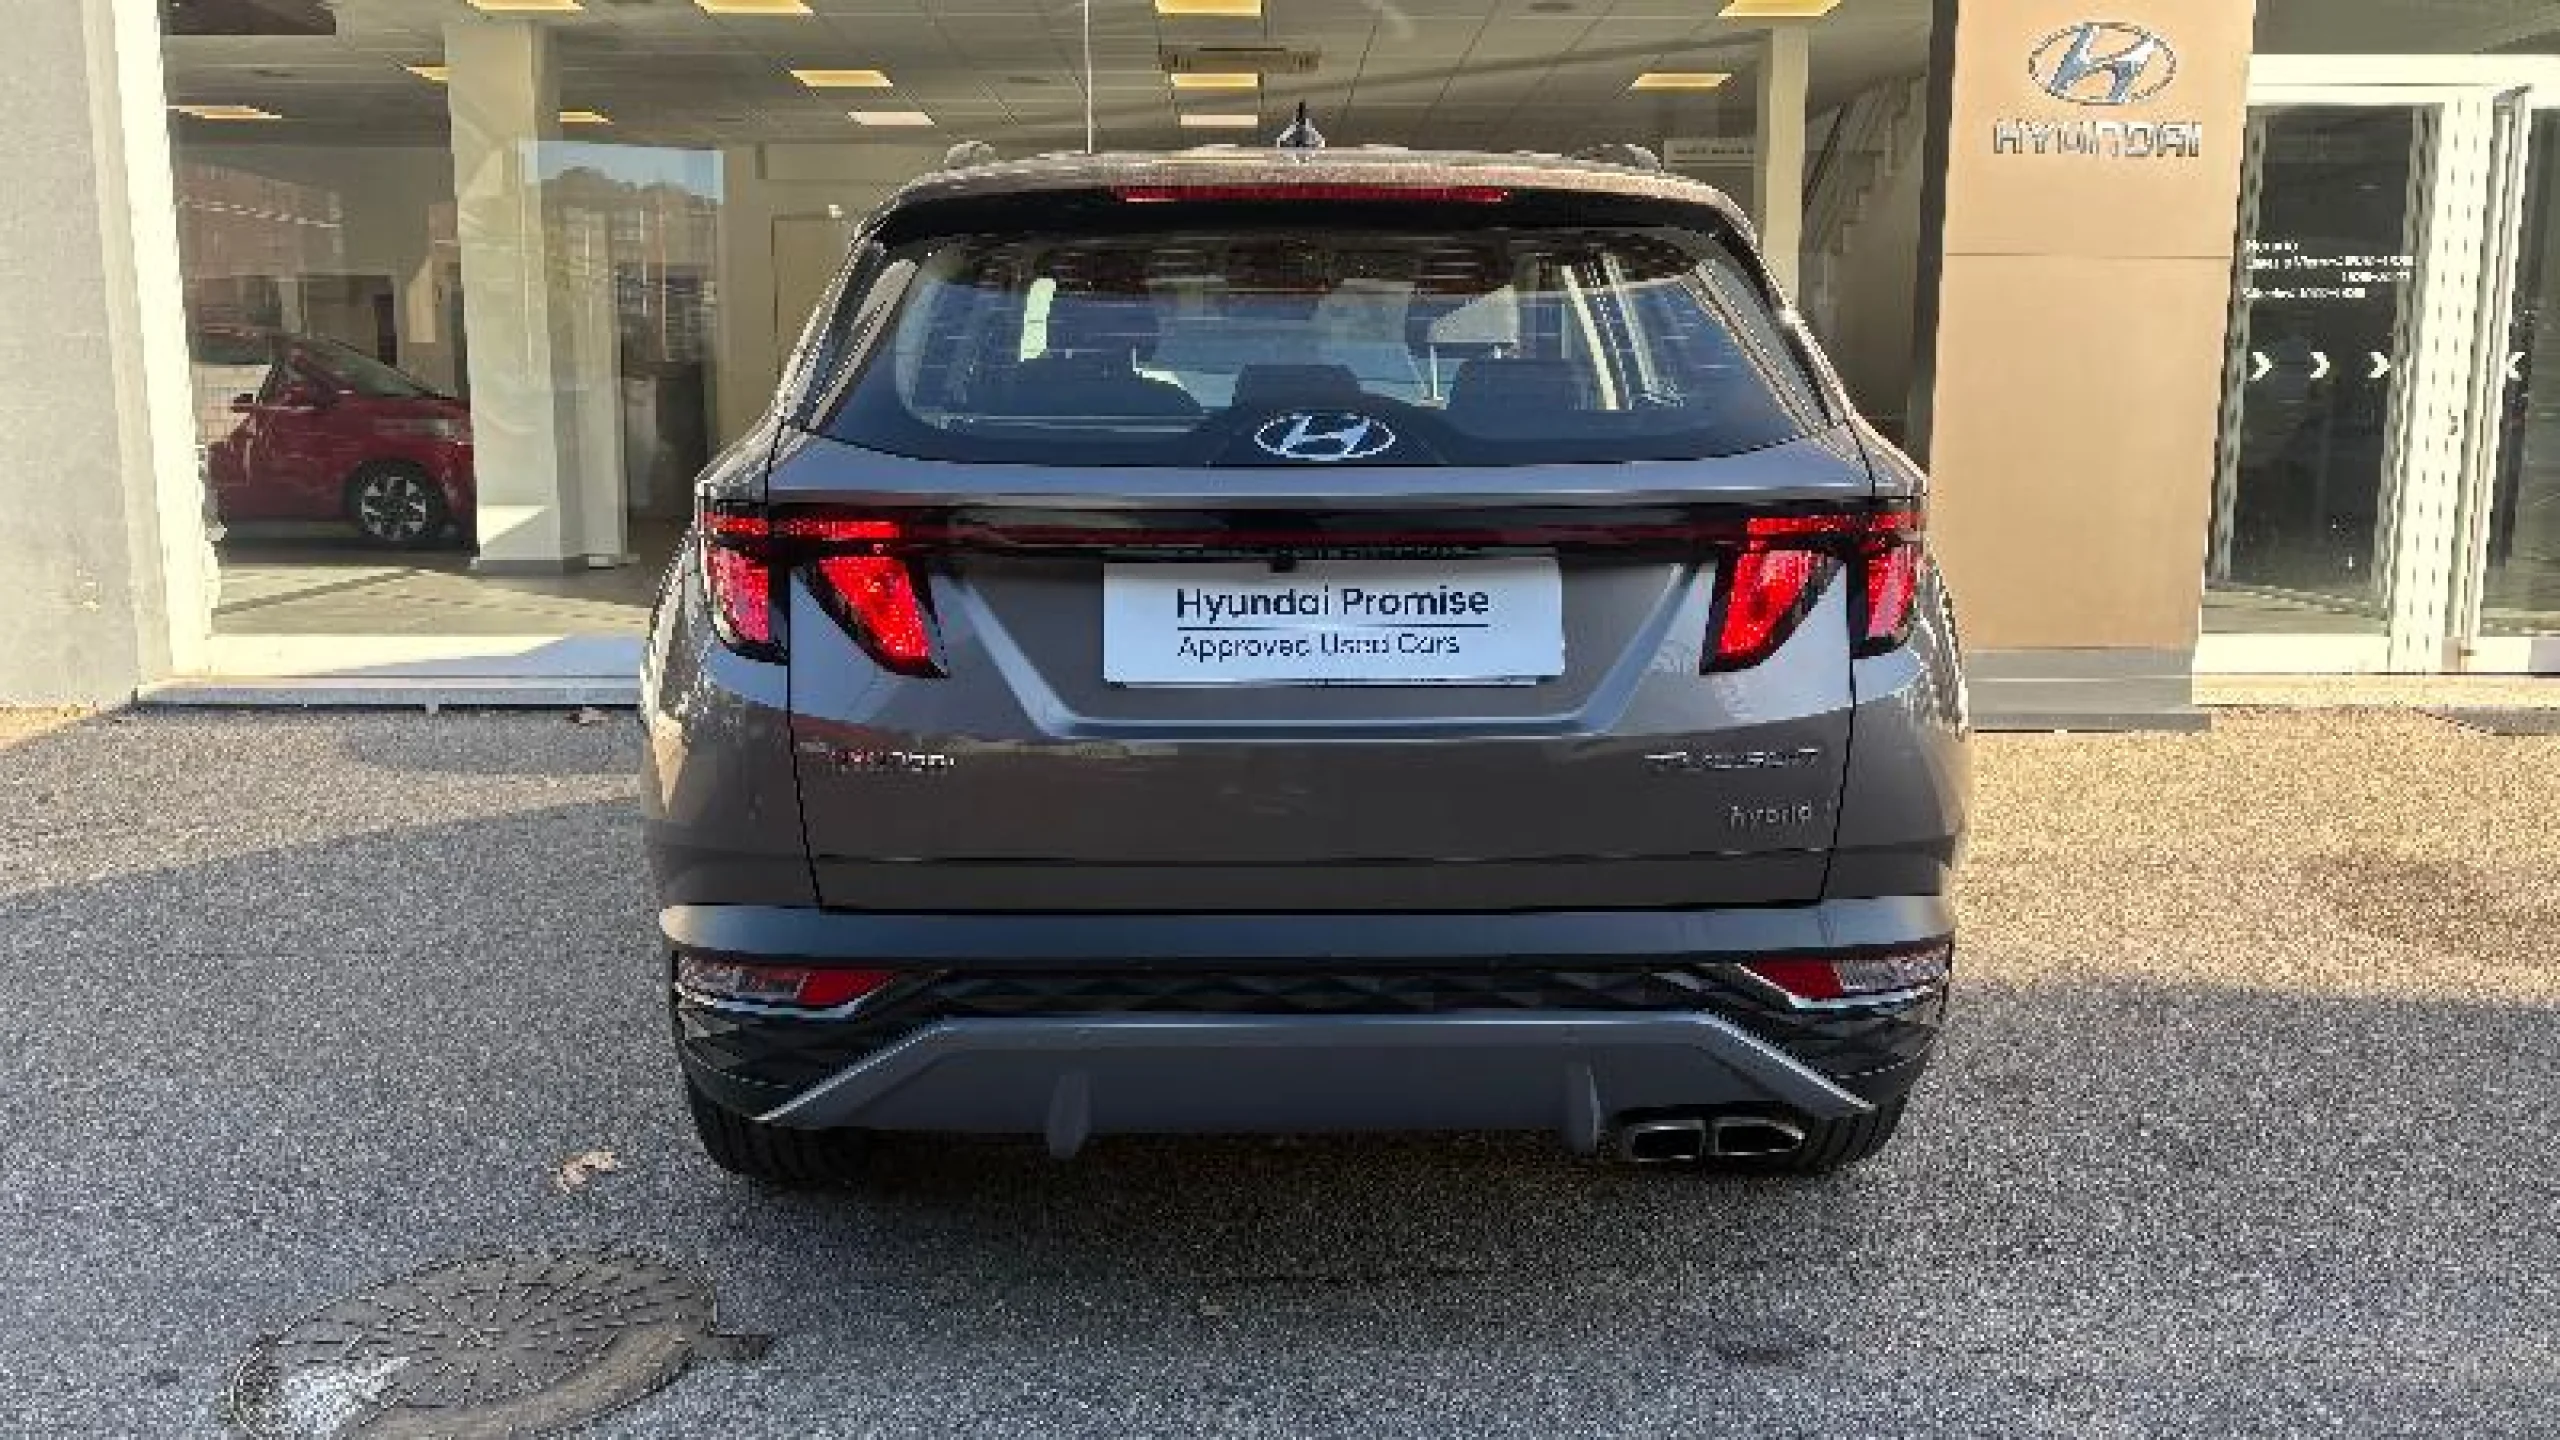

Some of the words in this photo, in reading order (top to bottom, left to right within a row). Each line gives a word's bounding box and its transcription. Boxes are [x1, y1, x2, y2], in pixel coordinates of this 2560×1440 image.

[1993, 119, 2203, 158] HYUNDAI
[1176, 585, 1330, 625] Hyundai
[1341, 585, 1490, 615] Promise
[1177, 635, 1310, 663] Approved
[1320, 633, 1390, 656] Used
[1397, 632, 1461, 655] Cars
